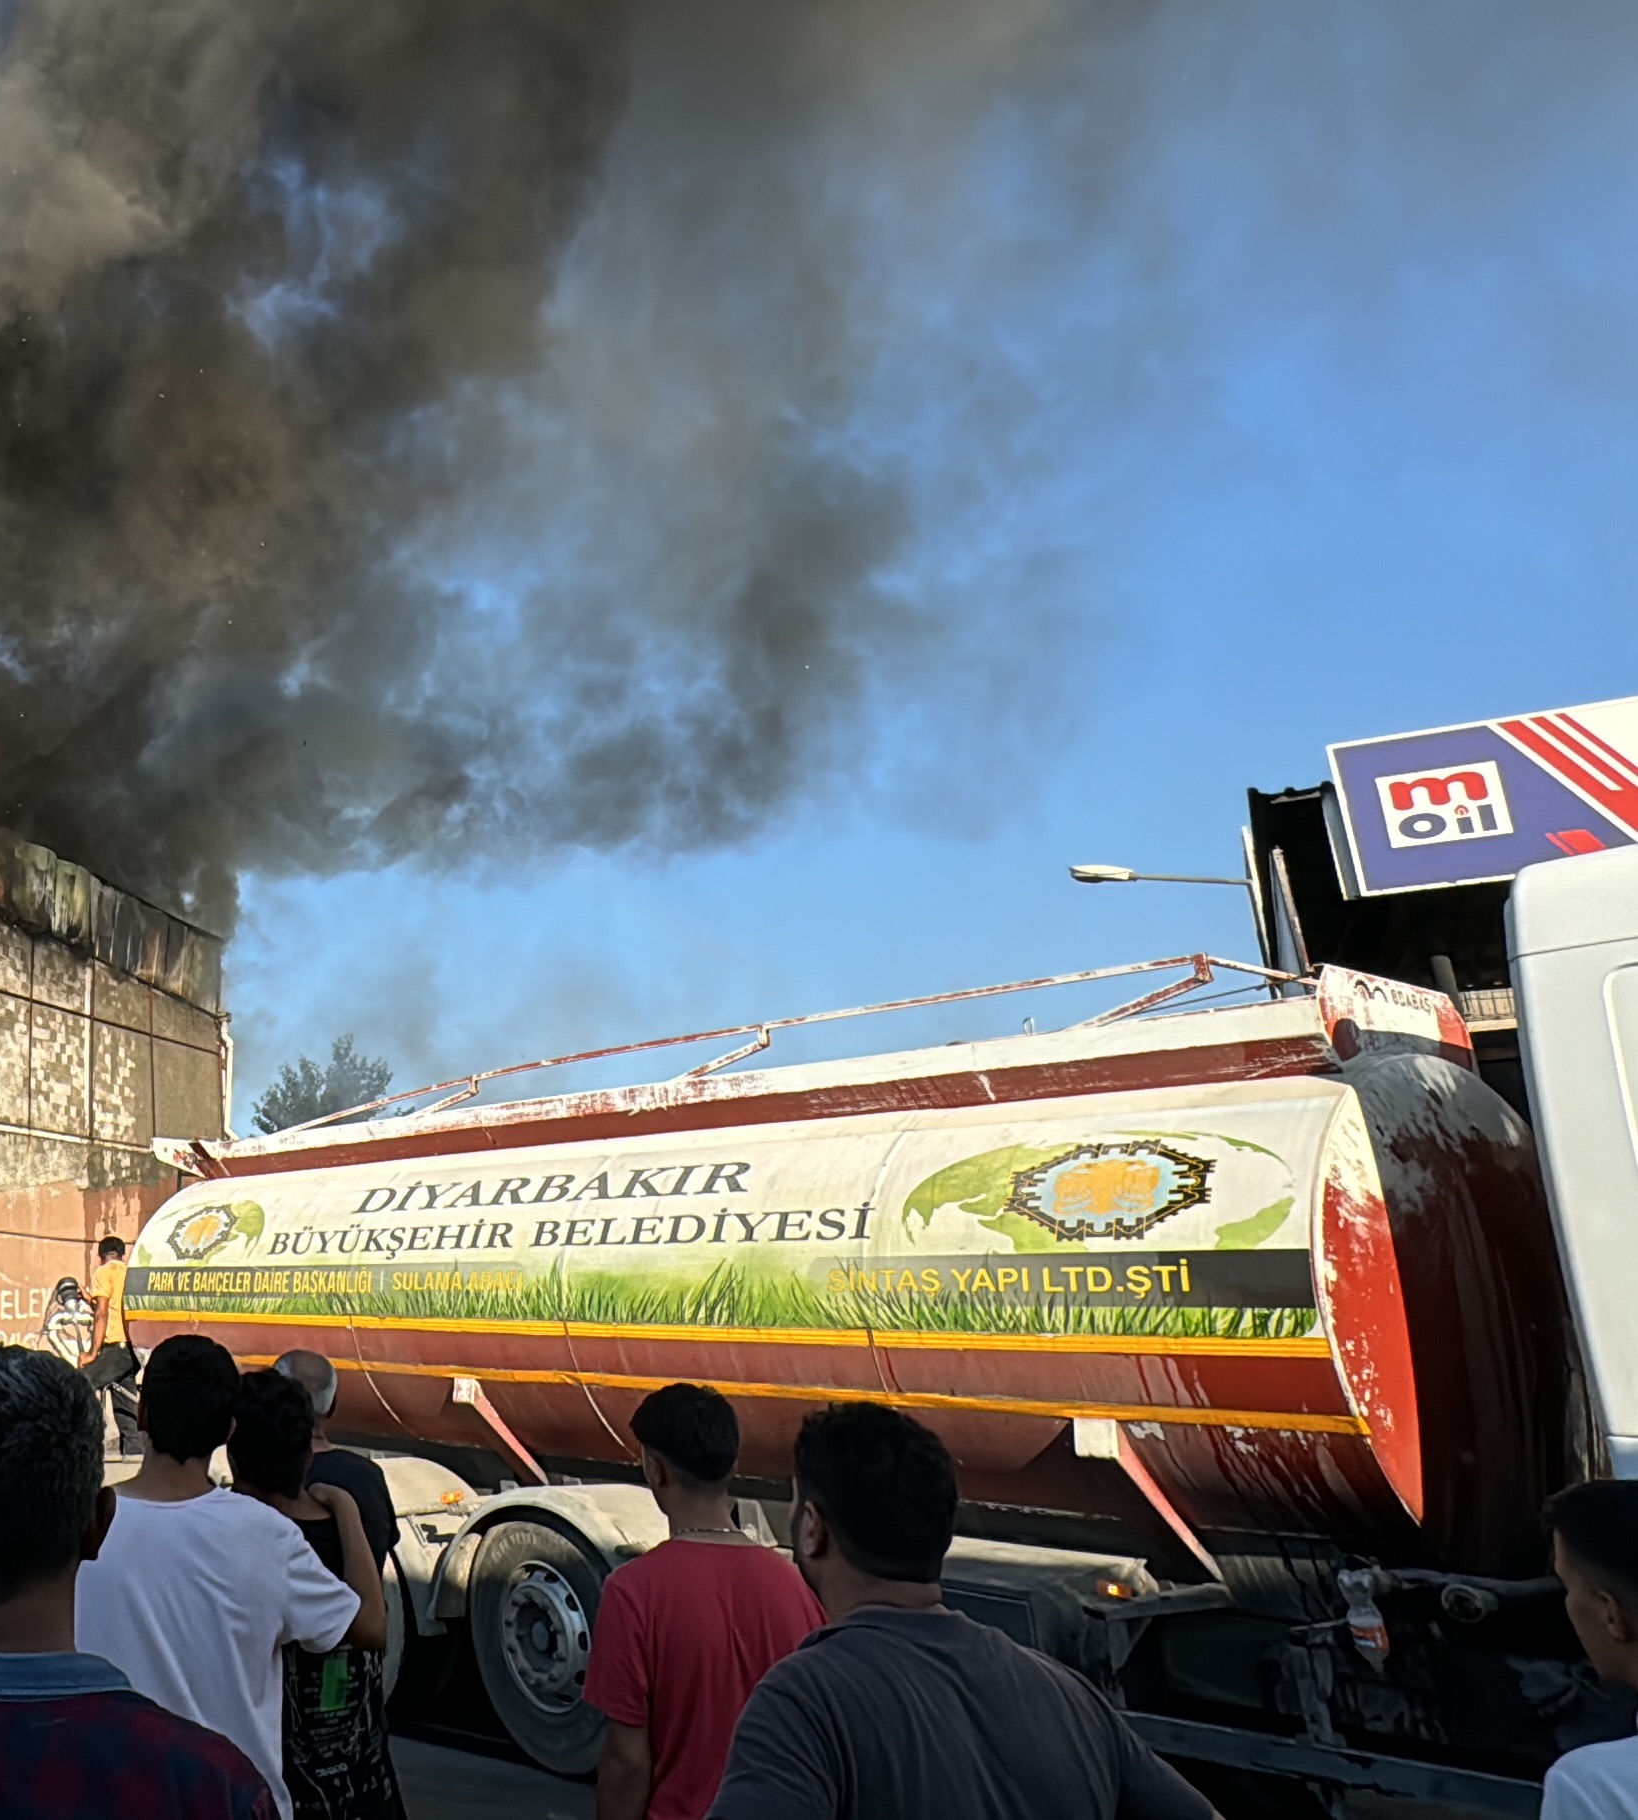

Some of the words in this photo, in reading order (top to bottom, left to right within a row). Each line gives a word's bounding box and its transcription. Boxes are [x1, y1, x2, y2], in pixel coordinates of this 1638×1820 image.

[1398, 803, 1498, 840] oil
[352, 1160, 752, 1214] DİYARBAKIR
[268, 1217, 514, 1261] BÜYÜKŞEHİR
[529, 1200, 876, 1249] BELEDİYESİ
[147, 1271, 175, 1293] PARK
[177, 1271, 192, 1292] VE
[193, 1270, 251, 1298] BAHÇELER
[253, 1266, 290, 1294] DAİRE
[292, 1266, 372, 1297] BAŞKANLIĞI
[392, 1271, 462, 1291] SULAMA
[827, 1262, 942, 1299] SİNTAŞ
[950, 1266, 1029, 1293] YAPI
[1042, 1258, 1191, 1299] LTD.ŞTİ
